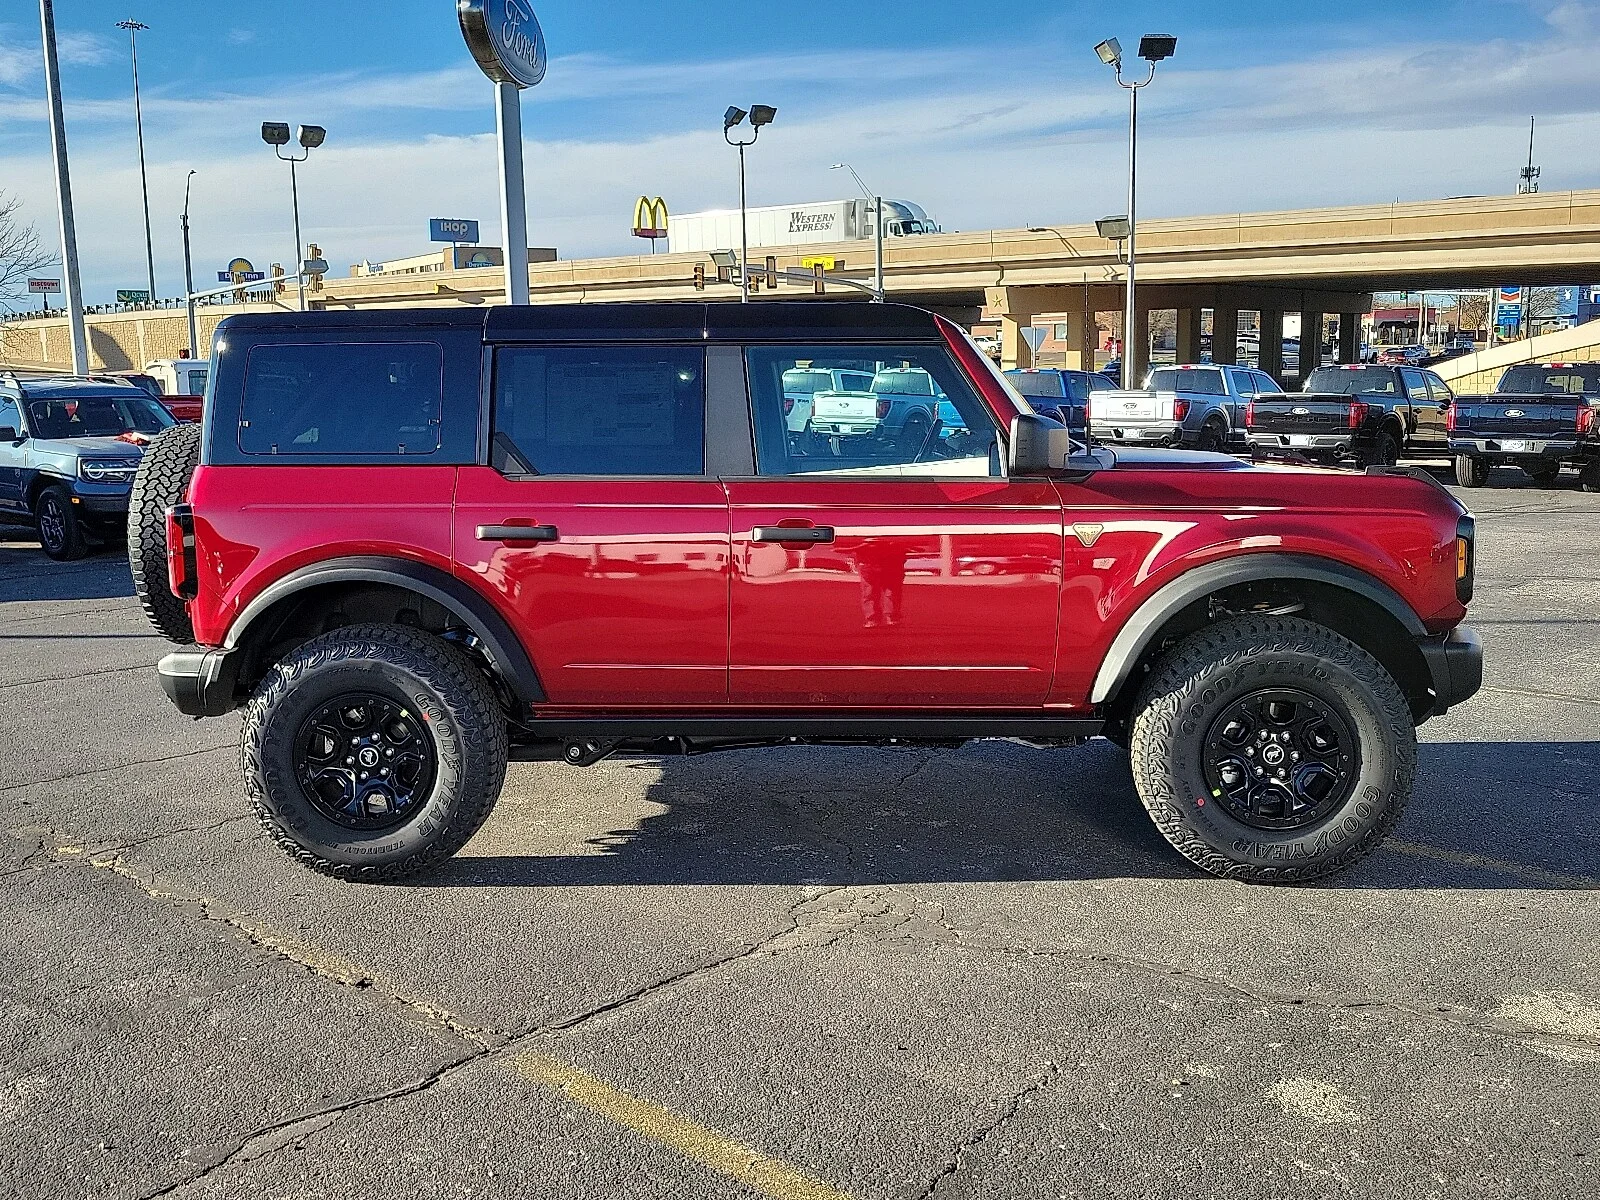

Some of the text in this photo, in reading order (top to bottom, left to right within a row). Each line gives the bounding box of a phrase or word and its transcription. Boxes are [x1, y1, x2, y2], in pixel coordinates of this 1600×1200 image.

[502, 0, 538, 68] Ford
[790, 212, 836, 225] WESTERN
[245, 272, 259, 280] Inn
